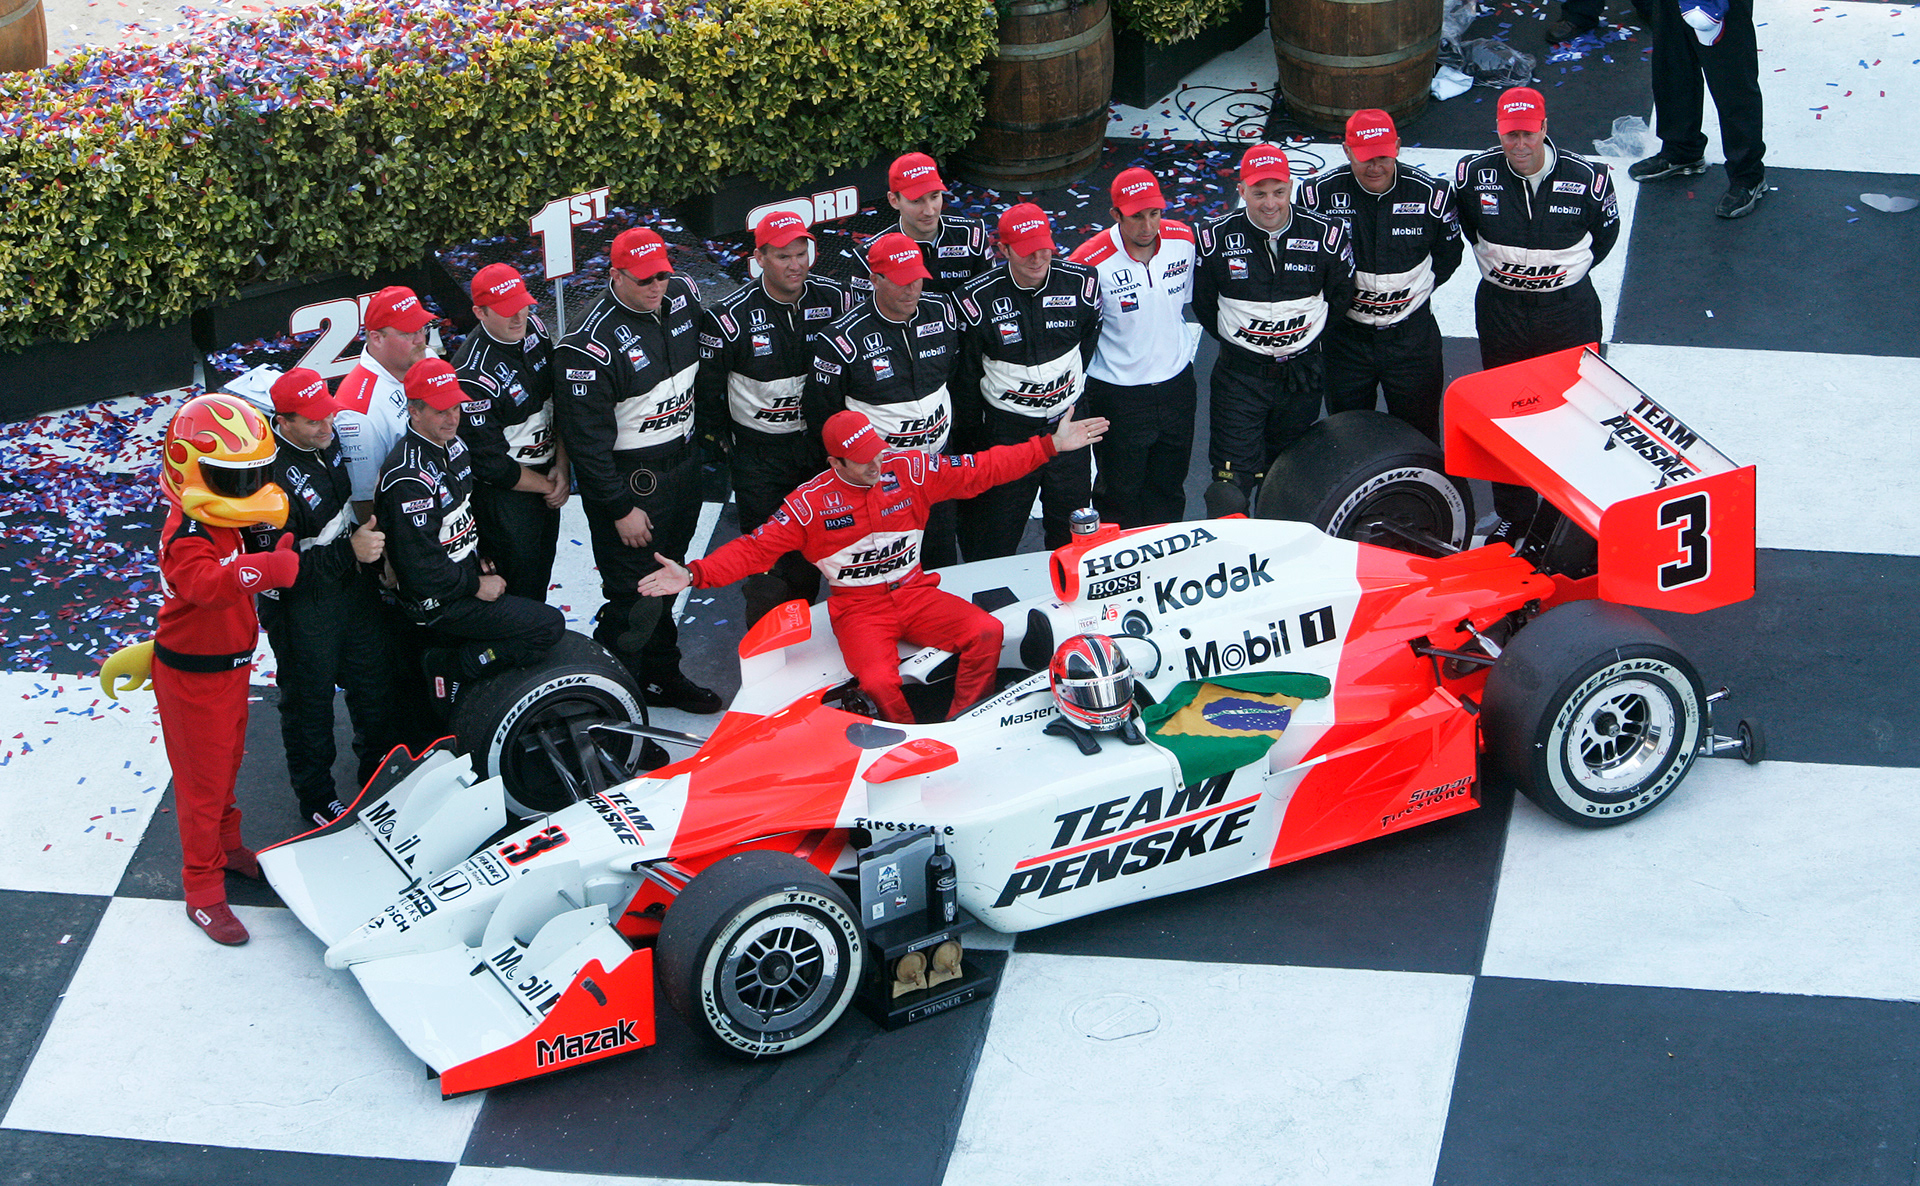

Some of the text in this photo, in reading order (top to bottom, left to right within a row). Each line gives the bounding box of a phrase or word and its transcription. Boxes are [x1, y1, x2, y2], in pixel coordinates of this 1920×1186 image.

[1503, 102, 1536, 110] Firestone
[1356, 127, 1390, 136] Firestone
[1363, 131, 1383, 140] Racing
[1249, 155, 1282, 165] Firestone
[1255, 160, 1275, 168] Racing
[903, 166, 936, 177] Firestone
[1121, 181, 1154, 194] Firestone
[1129, 186, 1148, 196] Racing
[1550, 205, 1574, 215] Mobil
[531, 187, 609, 280] 1ST
[1012, 220, 1045, 231] Firestone
[1020, 224, 1039, 234] Racing
[1392, 227, 1416, 236] Mobil
[889, 250, 919, 261] Firestone
[1221, 248, 1253, 257] HONDA
[1167, 259, 1187, 269] TEAM
[1284, 263, 1308, 272] Mobil
[1501, 262, 1562, 276] TEAM
[1110, 282, 1142, 295] HONDA
[1488, 270, 1567, 290] PENSKE
[991, 310, 1021, 324] HONDA
[1046, 319, 1068, 329] Mobil
[1248, 314, 1306, 331] TEAM
[619, 334, 642, 353] HONDA
[1233, 328, 1310, 348] PENSKE
[862, 346, 892, 360] HONDA
[1018, 370, 1072, 393] TEAM
[999, 383, 1075, 408] PENSKE
[1511, 394, 1541, 410] PEAK
[900, 403, 945, 433] TEAM
[1633, 394, 1699, 451] TEAM
[1599, 415, 1696, 482] PENSKE
[819, 504, 854, 516] HONDA
[881, 502, 904, 517] Mobil
[825, 515, 853, 528] BOSS
[851, 535, 908, 564] TEAM
[1657, 491, 1711, 592] 3
[1083, 527, 1218, 578] HONDA
[837, 546, 917, 580] PENSKE
[1091, 573, 1139, 595] BOSS
[1154, 553, 1275, 614] Kodak
[1184, 619, 1292, 680] Mobil
[971, 674, 1047, 718] CASTRONEVES
[1556, 661, 1671, 730] FIREHAWK
[495, 676, 591, 746] FIREHAWK
[1408, 775, 1473, 805] Snap-on
[1586, 752, 1689, 815] Firestone
[607, 791, 655, 831] TEAM
[1050, 769, 1236, 850] TEAM
[1381, 786, 1467, 830] Firestone
[498, 825, 570, 867] 3
[992, 804, 1257, 909] PENSKE
[787, 892, 860, 953] Firestone
[923, 996, 961, 1015] WINNER
[702, 989, 786, 1053] FIREHAWK
[535, 1017, 641, 1069] Mazak
